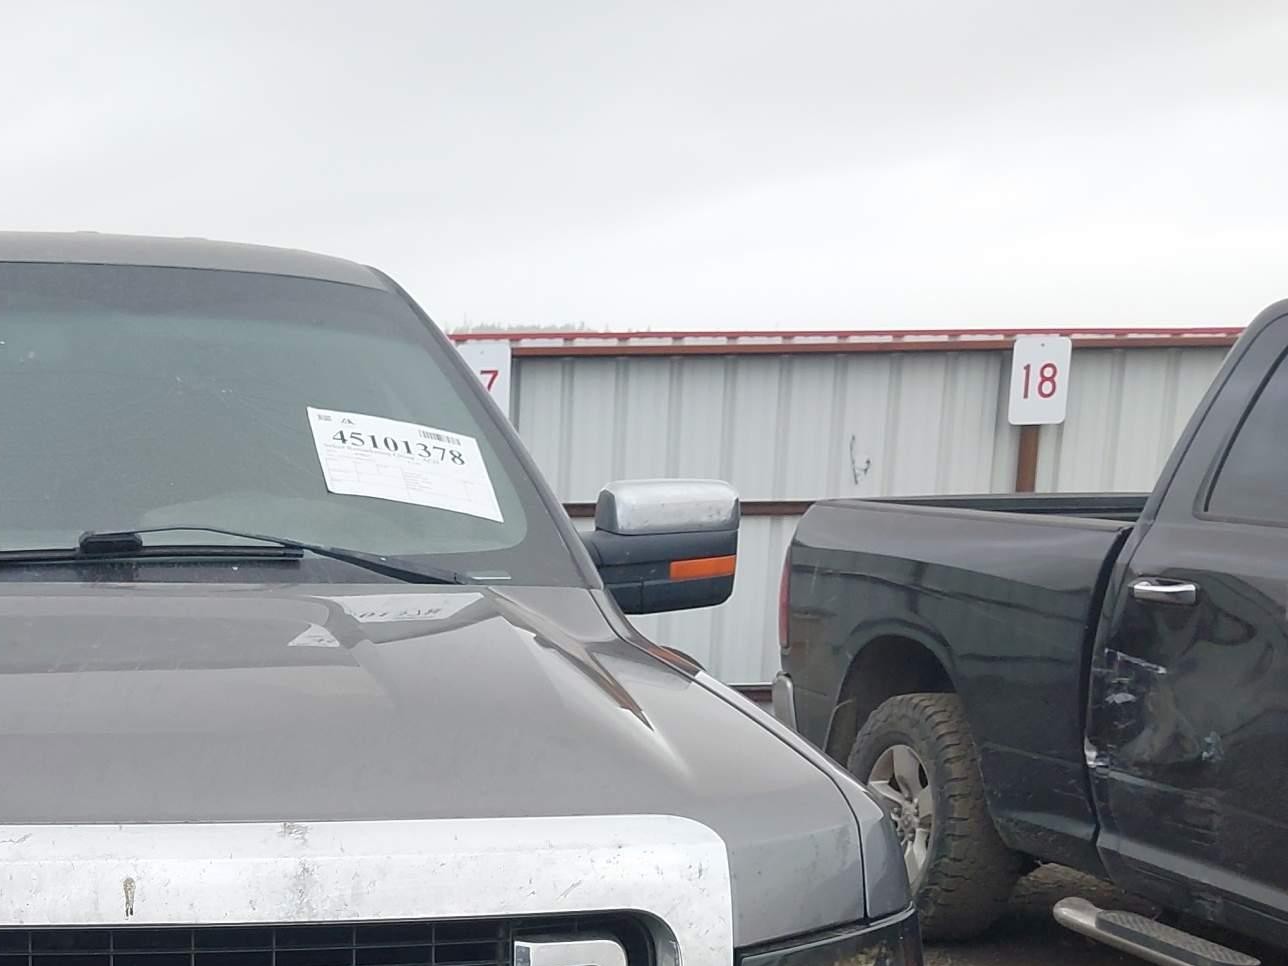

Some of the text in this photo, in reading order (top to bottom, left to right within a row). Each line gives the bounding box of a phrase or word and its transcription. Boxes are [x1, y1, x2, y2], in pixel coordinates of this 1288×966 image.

[480, 370, 499, 393] 7
[1023, 363, 1058, 400] 18
[332, 430, 466, 466] 45101378
